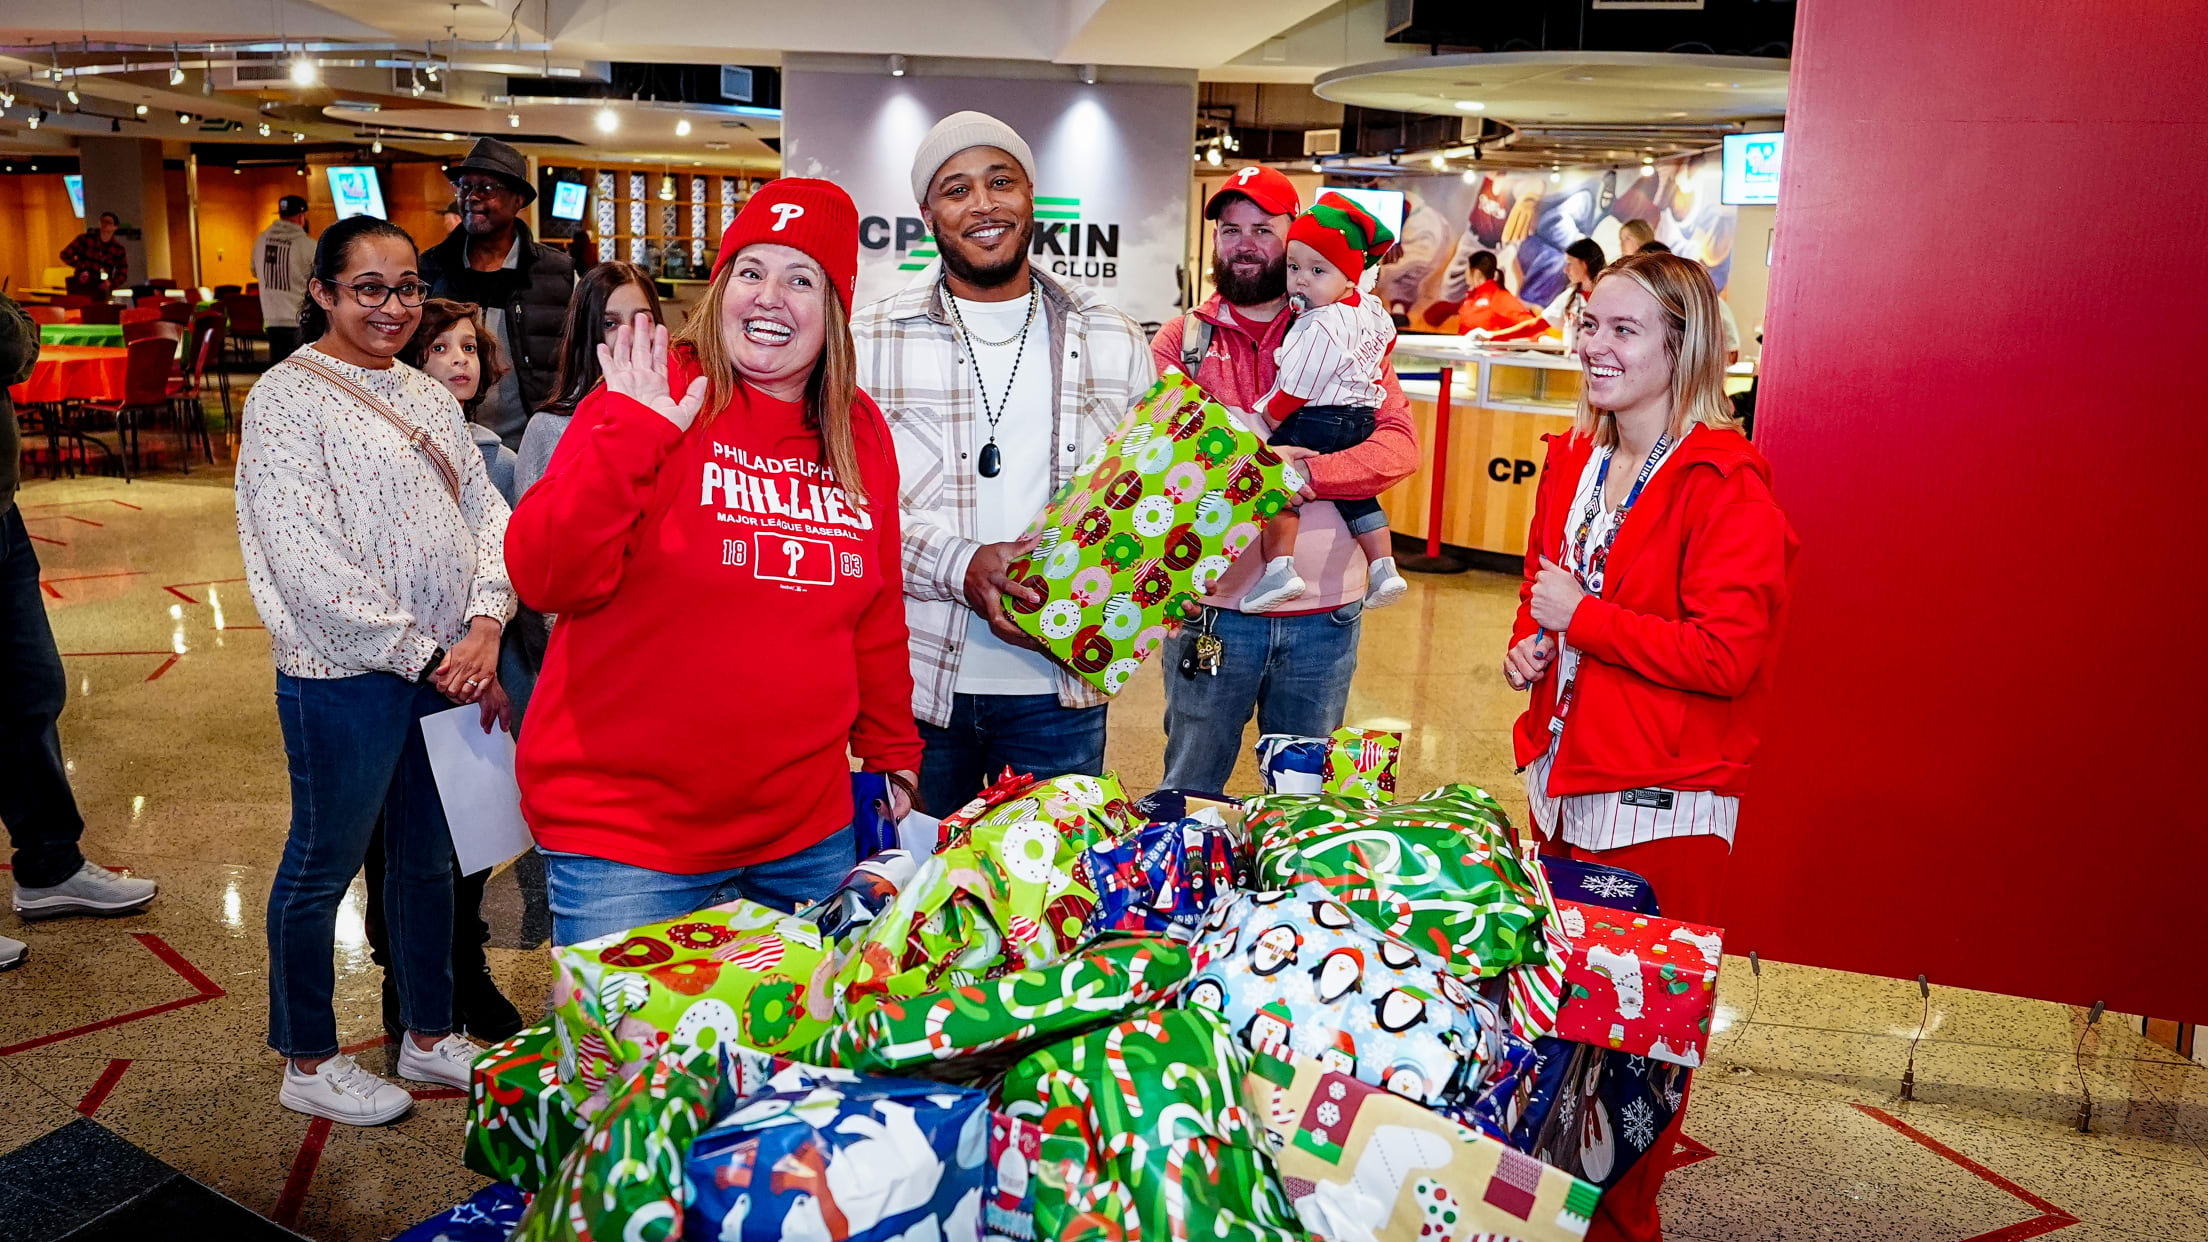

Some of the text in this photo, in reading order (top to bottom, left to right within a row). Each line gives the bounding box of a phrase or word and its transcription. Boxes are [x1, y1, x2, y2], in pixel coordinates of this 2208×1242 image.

[1238, 167, 1260, 186] P
[770, 203, 805, 232] P
[1033, 221, 1119, 257] KIN
[1052, 260, 1117, 278] CLUB
[713, 440, 835, 482] PHILADELPH
[700, 462, 874, 531] PHILLIES
[717, 512, 758, 526] MAJOR
[760, 518, 803, 533] LEAGUE
[722, 539, 864, 578] 18 83
[782, 540, 805, 577] P
